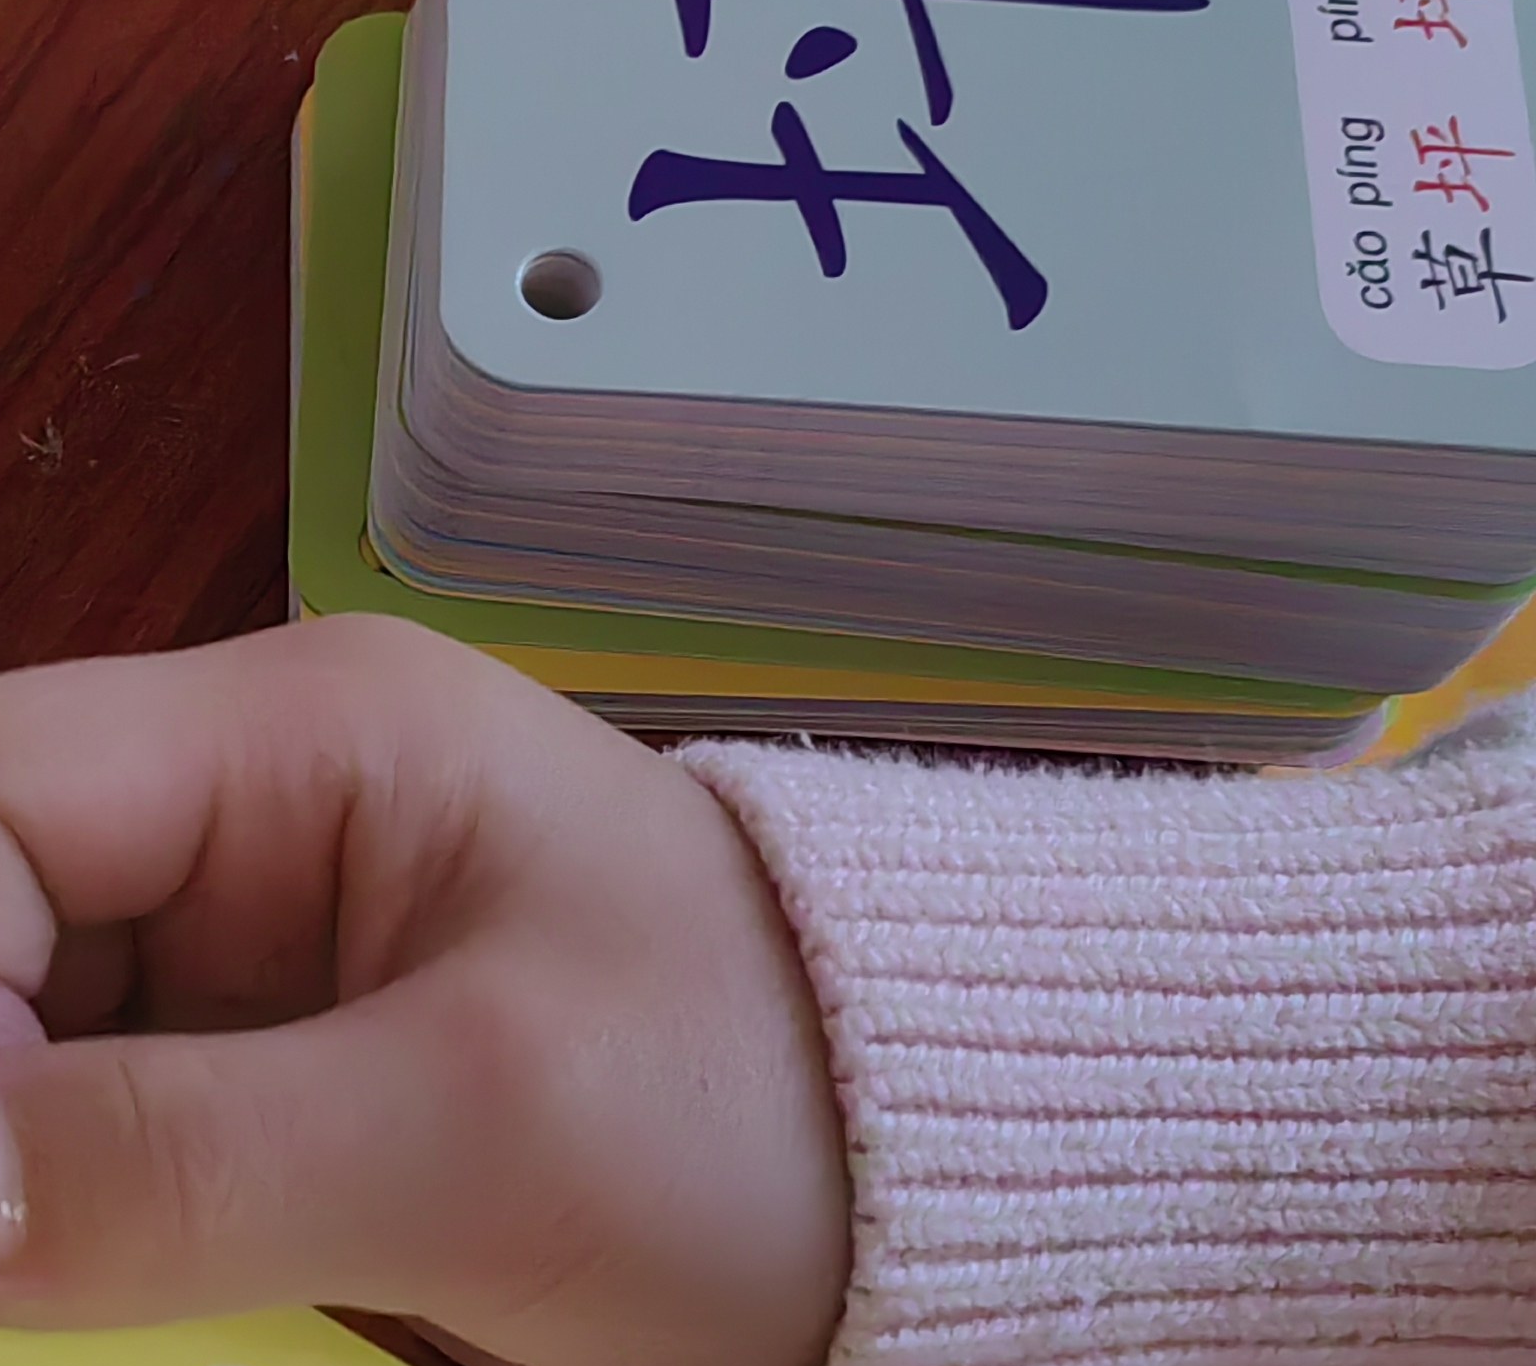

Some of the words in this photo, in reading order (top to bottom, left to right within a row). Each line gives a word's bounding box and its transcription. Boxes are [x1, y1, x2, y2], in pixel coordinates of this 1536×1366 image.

[1336, 117, 1392, 209] píng
[1410, 116, 1536, 324] 草坪
[1345, 230, 1395, 311] cǎo
